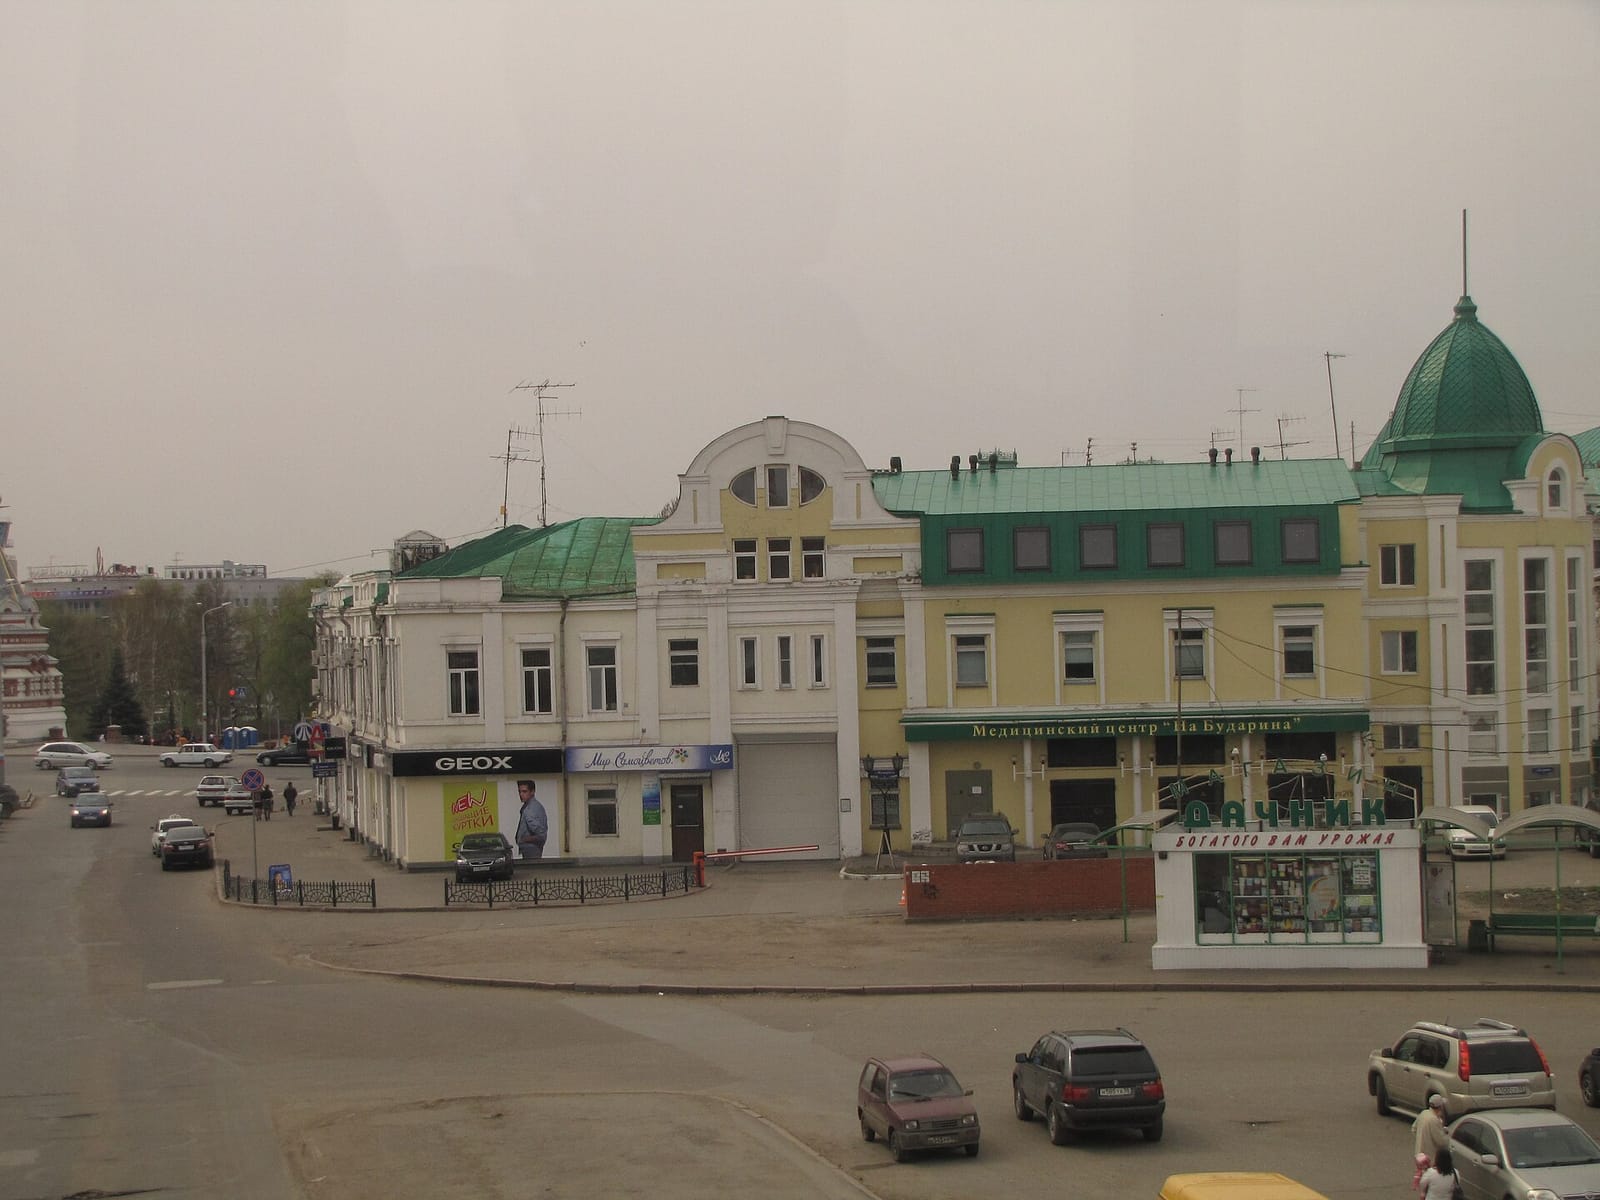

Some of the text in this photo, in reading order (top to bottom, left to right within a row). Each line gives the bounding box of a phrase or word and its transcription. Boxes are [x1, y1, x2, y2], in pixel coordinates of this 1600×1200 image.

[972, 723, 1100, 739] Медицинский
[1106, 720, 1159, 736] центр
[435, 756, 513, 771] GEOX
[585, 752, 611, 770] Мир
[1169, 757, 1400, 799] МАГАЗИН
[1183, 798, 1387, 828] ДАЧНИК
[1175, 832, 1396, 848] БОГАТОГО ВАМ УРОЖАЯ
